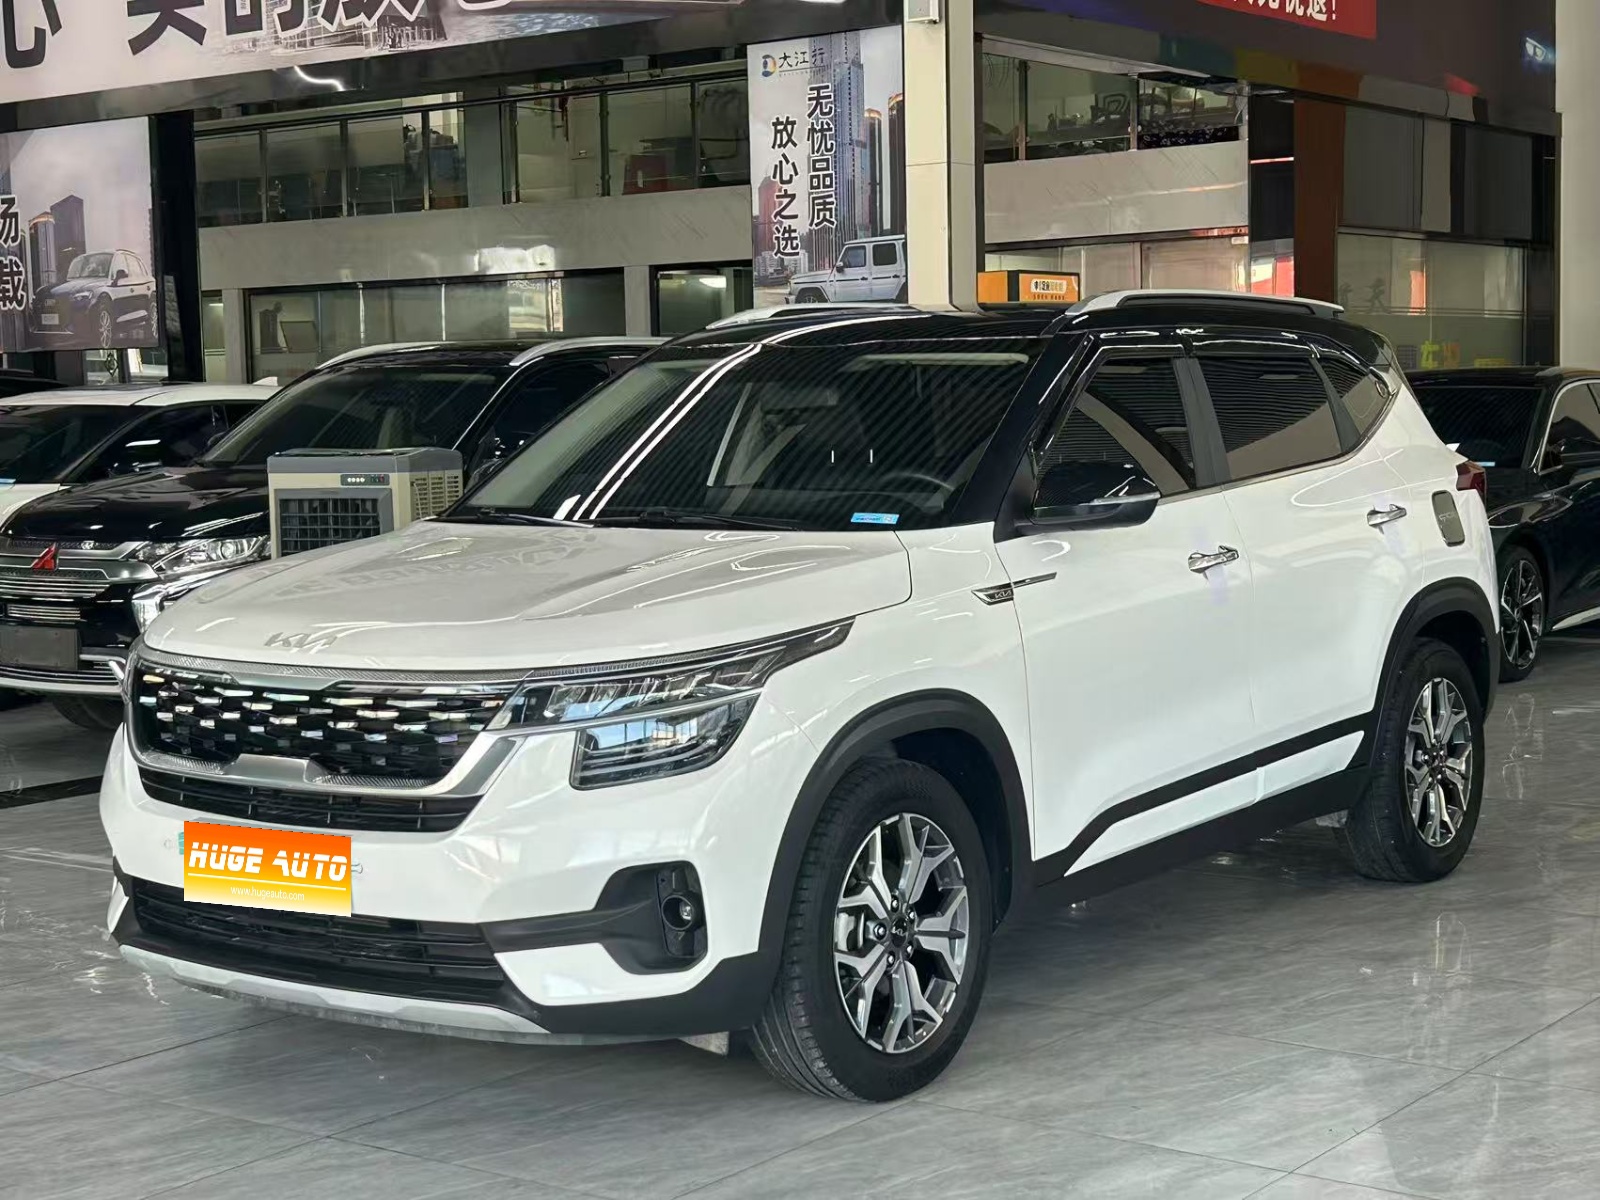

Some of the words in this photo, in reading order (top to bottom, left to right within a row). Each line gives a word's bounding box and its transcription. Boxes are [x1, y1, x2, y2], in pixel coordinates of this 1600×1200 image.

[778, 48, 825, 68] 大江行
[771, 115, 800, 258] 放心之选
[806, 83, 836, 229] 无忧品质
